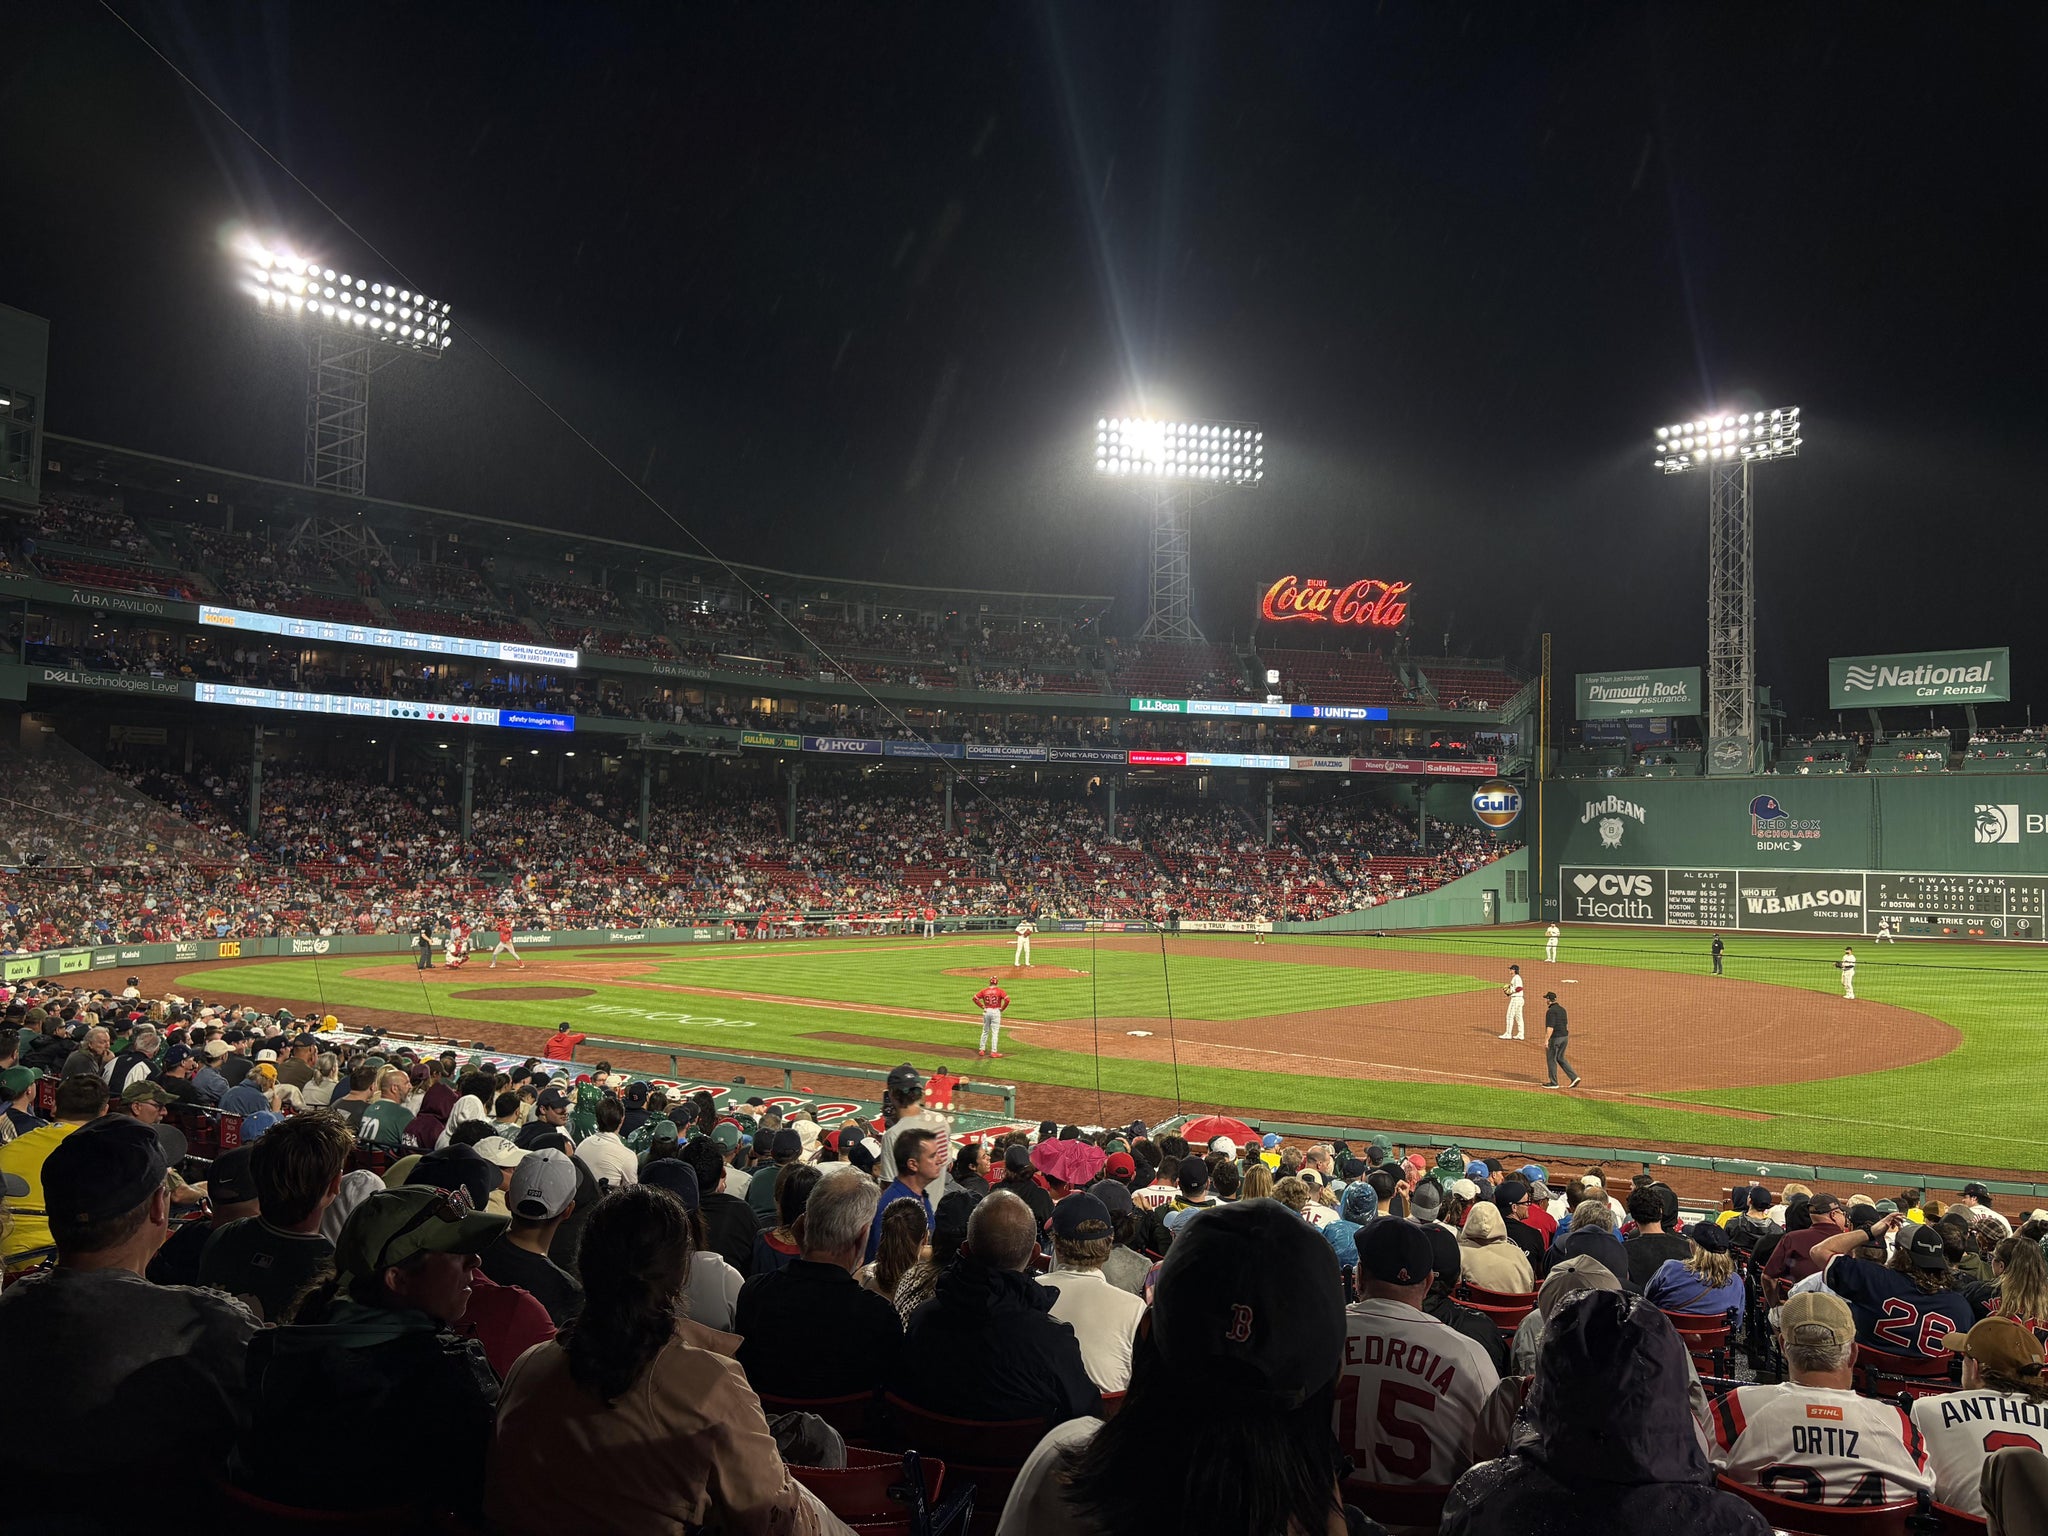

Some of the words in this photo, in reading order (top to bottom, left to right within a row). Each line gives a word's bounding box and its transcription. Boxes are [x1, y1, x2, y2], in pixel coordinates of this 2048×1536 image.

[1262, 575, 1411, 625] Coca-Cola
[113, 599, 164, 614] PAVILION
[503, 645, 533, 655] COGHLIN
[534, 649, 574, 659] COMPANIES
[1877, 661, 1993, 687] National
[44, 670, 79, 683] DELL
[80, 673, 149, 691] Technologies
[151, 682, 179, 693] Level
[1589, 684, 1650, 700] Plymouth
[1653, 681, 1688, 696] Rock
[1916, 688, 1939, 696] Car
[1943, 685, 1986, 695] Rental
[1642, 696, 1688, 704] assurance
[354, 702, 370, 711] MVR
[398, 702, 415, 710] BALL
[426, 704, 448, 712] STRIKE
[477, 712, 495, 721] 8TH
[1325, 708, 1367, 719] UNITED
[509, 716, 528, 724] xfinity
[529, 718, 551, 727] Imagine
[744, 736, 775, 745] SULLIVAN
[832, 741, 865, 751] HYCU
[969, 746, 1000, 754] COGHLIN
[1002, 747, 1046, 756] COMPANIES
[1060, 751, 1099, 759] VINEYARD
[1314, 760, 1342, 768] AMAZING
[1365, 762, 1383, 770] Ninety
[1427, 764, 1461, 773] Safelite
[1474, 795, 1519, 811] Gulf
[1581, 801, 1606, 824] JIM
[1607, 795, 1646, 825] BEAM
[1757, 820, 1786, 830] RED
[1790, 820, 1821, 830] SOX
[1757, 830, 1821, 839] SCHOLARS
[1757, 842, 1790, 851] BIDMC
[1599, 874, 1653, 896] CVS
[1741, 889, 1760, 897] WHO
[1761, 889, 1776, 897] BUT
[1544, 899, 1557, 907] 310
[1576, 897, 1653, 919] Health
[513, 935, 551, 943] smartwater
[219, 942, 240, 957] 006
[293, 945, 313, 953] Nine
[583, 1004, 758, 1027] WHOOP
[43, 1095, 53, 1106] 23
[226, 1133, 237, 1144] 22
[1873, 1297, 1957, 1358] 26
[1345, 1336, 1456, 1396] EDROIA
[1811, 1408, 1840, 1418] STIHL
[1341, 1375, 1437, 1479] 15
[1793, 1425, 1860, 1460] ORTIZ
